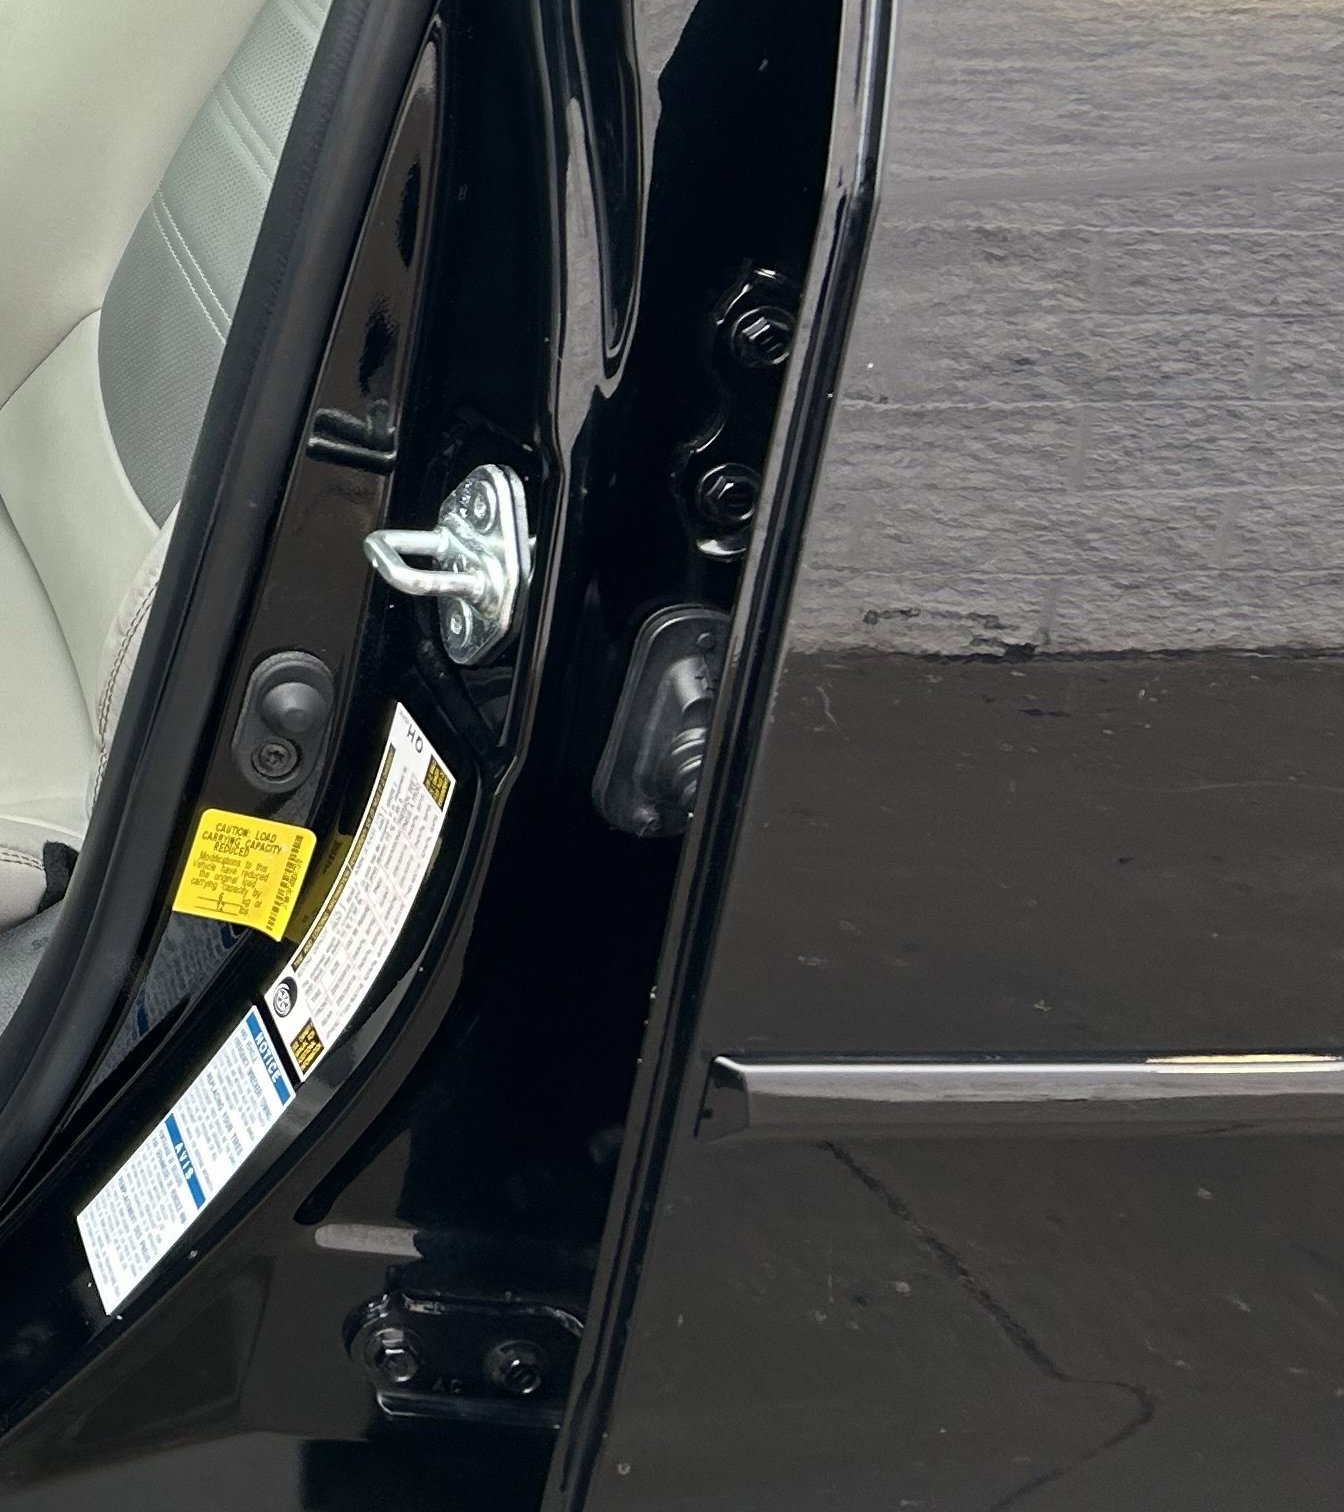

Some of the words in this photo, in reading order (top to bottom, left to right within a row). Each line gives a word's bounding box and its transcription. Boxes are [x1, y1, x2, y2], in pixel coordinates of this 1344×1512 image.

[202, 831, 241, 846] CARRYING
[245, 840, 282, 855] CAPACITY
[214, 841, 250, 857] REDUCED
[255, 830, 277, 844] LOAD
[255, 1032, 281, 1083] NOTICE
[175, 1142, 194, 1180] AVIS
